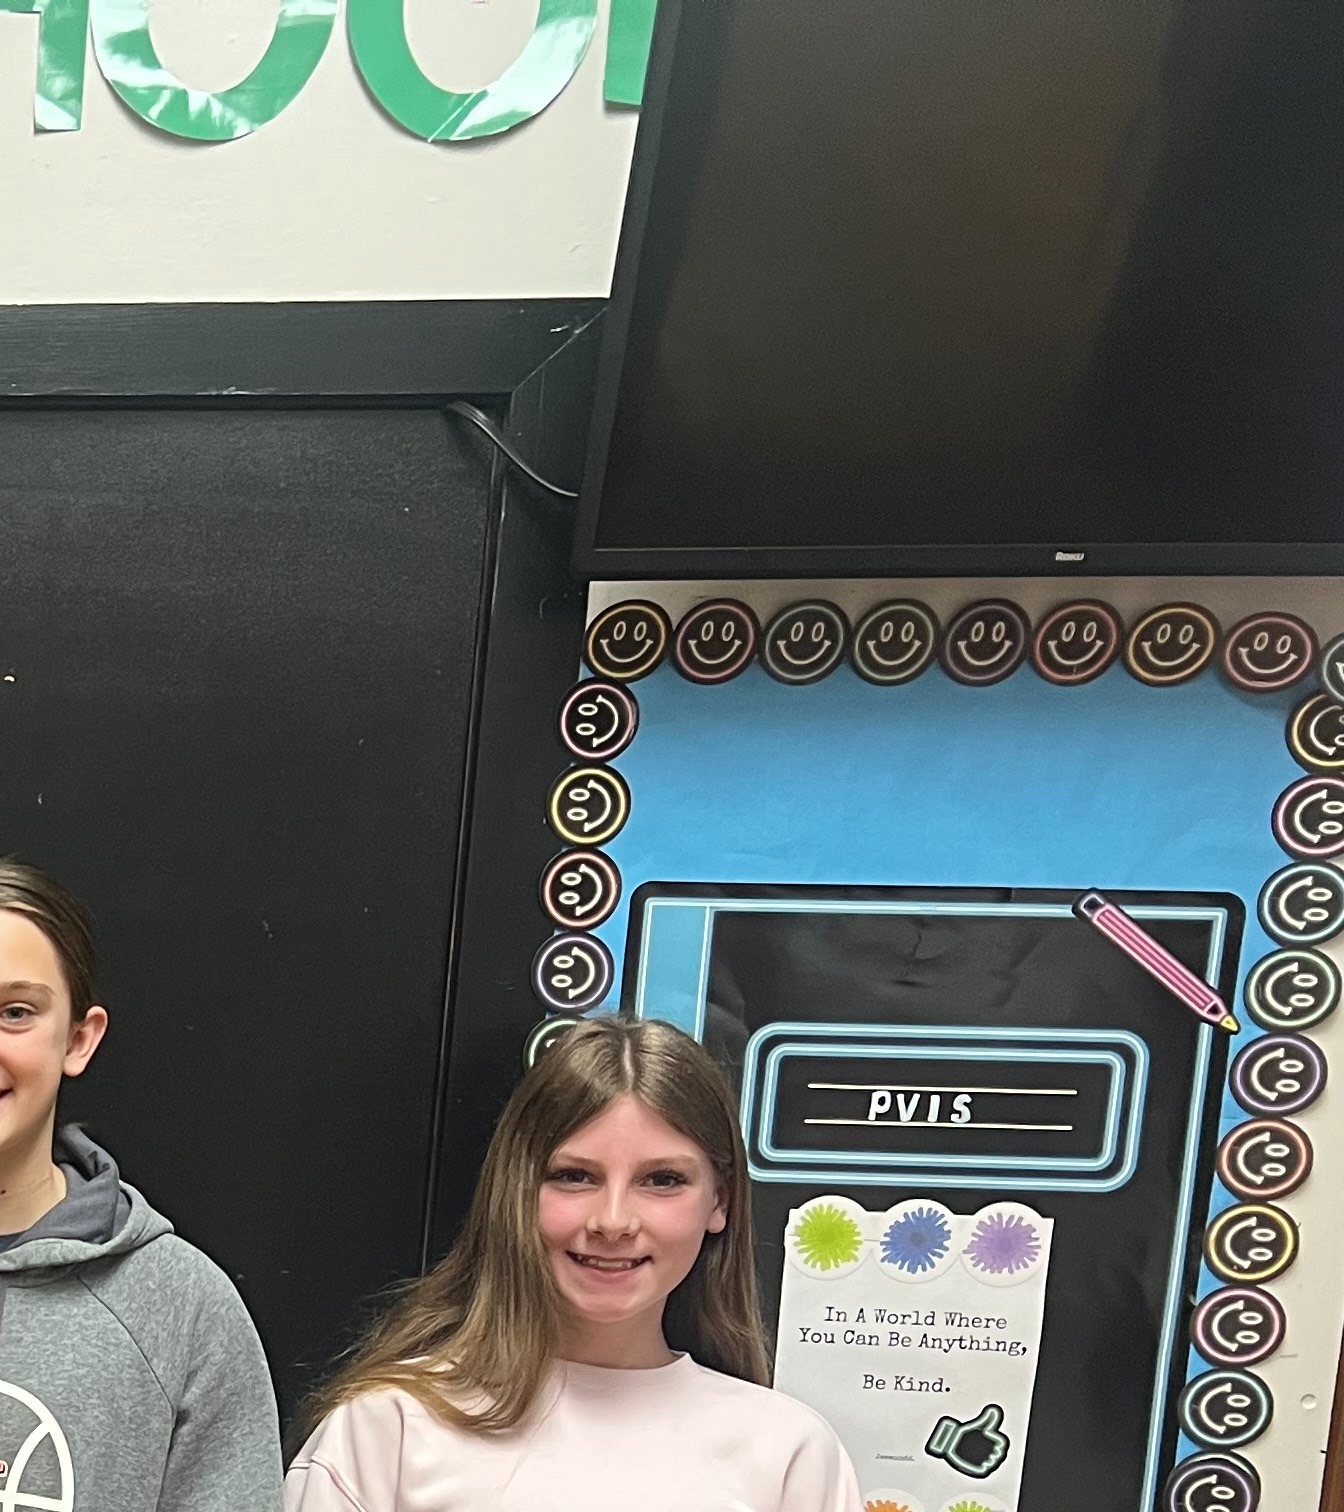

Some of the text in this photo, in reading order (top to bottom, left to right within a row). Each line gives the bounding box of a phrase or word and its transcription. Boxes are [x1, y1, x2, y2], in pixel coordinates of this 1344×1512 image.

[868, 1090, 972, 1124] PVIS
[824, 1306, 1008, 1330] In A World Where
[799, 1327, 1027, 1356] You Can Be Anything,
[862, 1374, 952, 1393] Be Kind.
